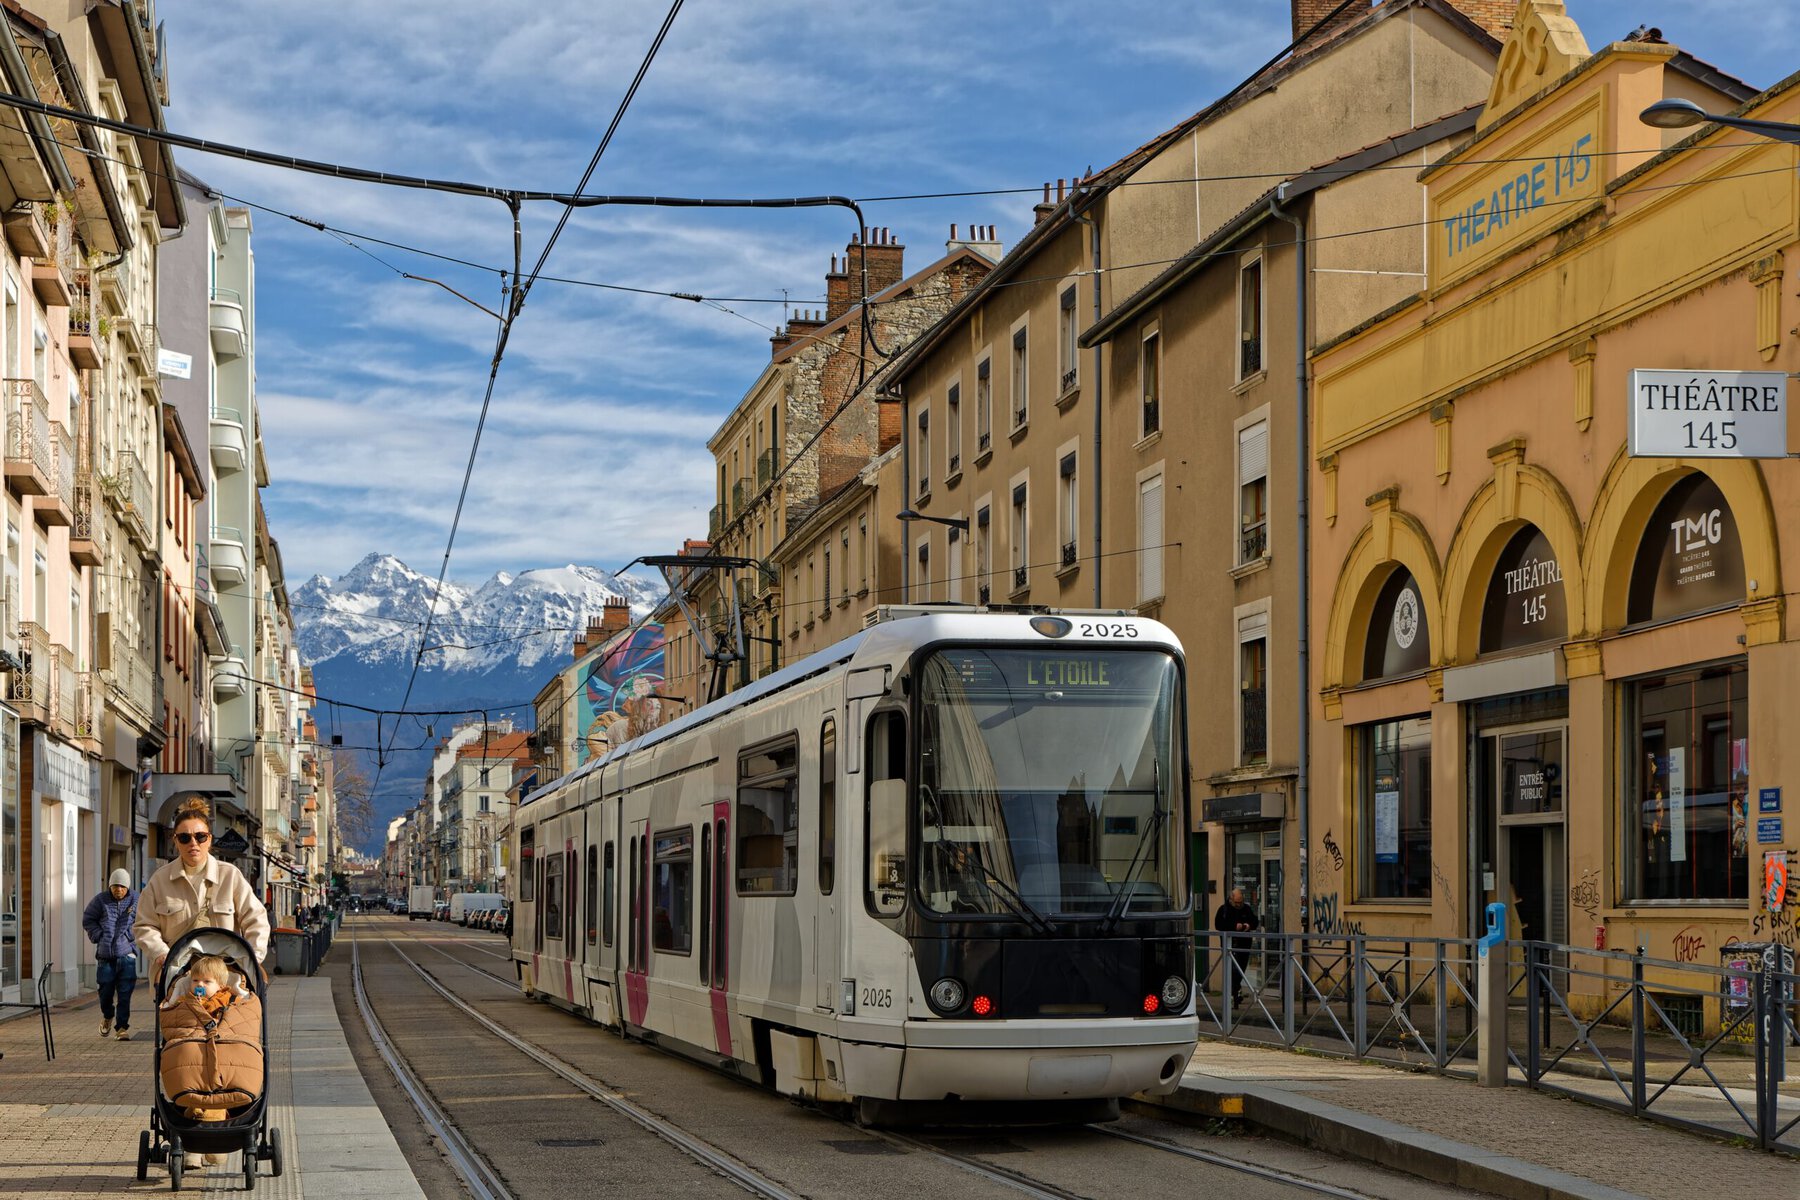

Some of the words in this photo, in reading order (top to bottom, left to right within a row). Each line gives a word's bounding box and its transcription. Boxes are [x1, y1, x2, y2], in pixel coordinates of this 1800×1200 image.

[1445, 162, 1546, 258] THEATRE
[1554, 133, 1592, 197] 145
[1640, 378, 1779, 412] THÉÂTRE
[1682, 421, 1738, 449] 145
[1671, 508, 1721, 554] TMG
[1522, 593, 1547, 625] 145
[1080, 623, 1139, 639] 2025
[1027, 660, 1110, 685] L'ETOILE
[1519, 770, 1544, 786] ENTRÉE
[1520, 787, 1543, 800] PUBLIC
[1753, 915, 1766, 936] ST
[862, 987, 892, 1008] 2025
